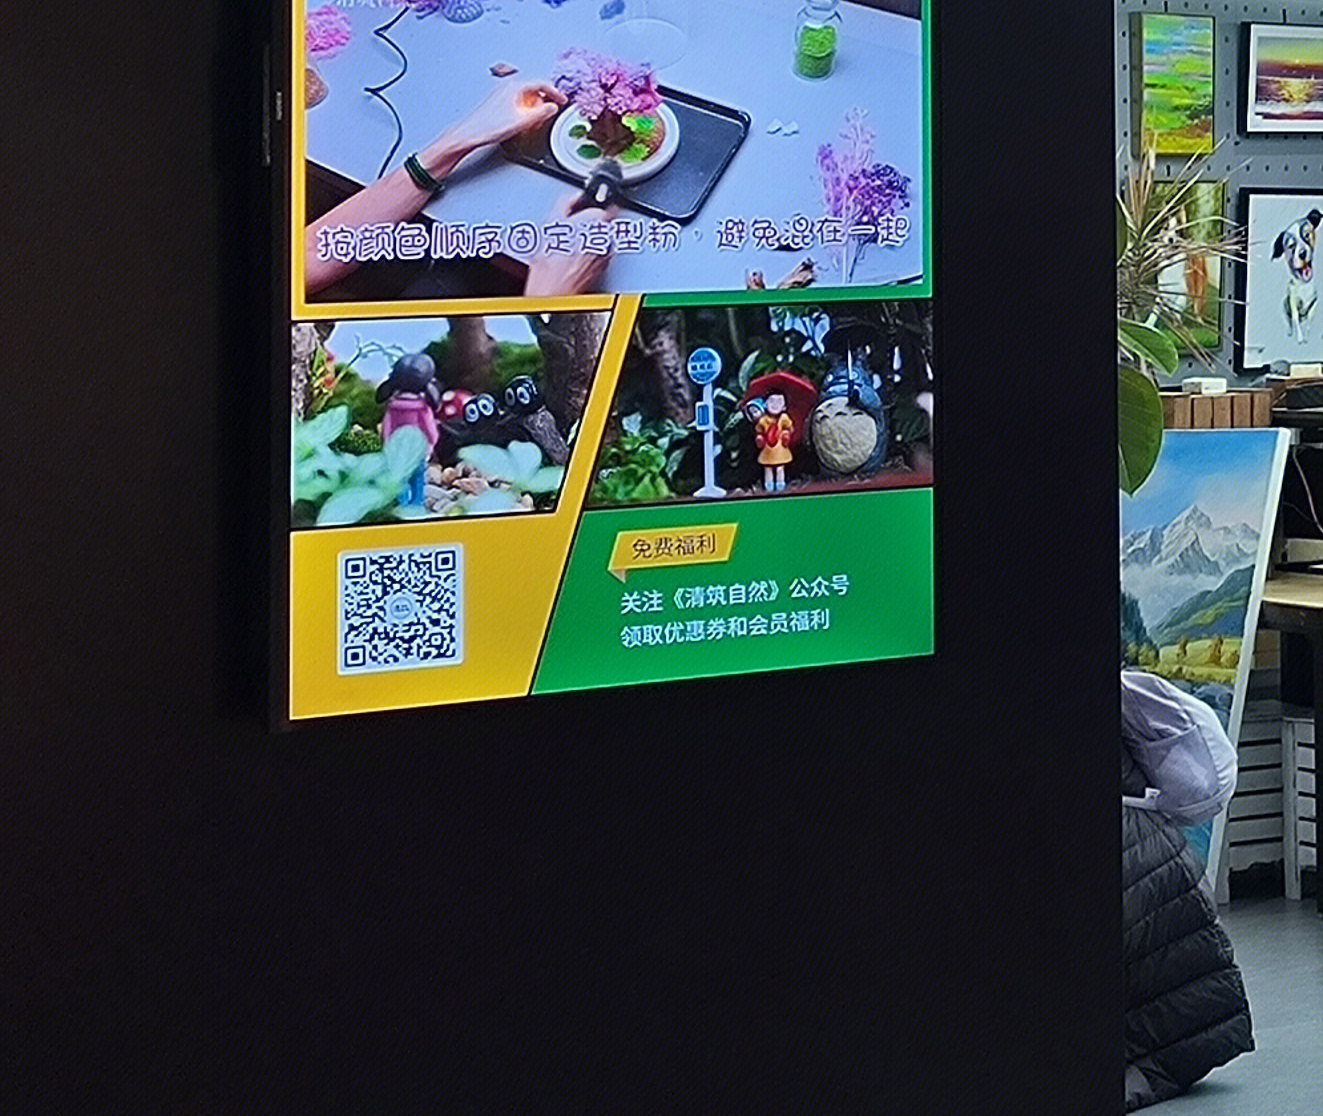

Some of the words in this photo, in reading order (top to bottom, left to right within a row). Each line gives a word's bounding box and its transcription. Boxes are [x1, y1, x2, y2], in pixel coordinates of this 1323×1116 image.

[631, 533, 716, 560] 免费福利
[620, 574, 850, 615] 关注《清筑自然》公众号
[620, 608, 830, 648] 领取优惠券和会员福利
